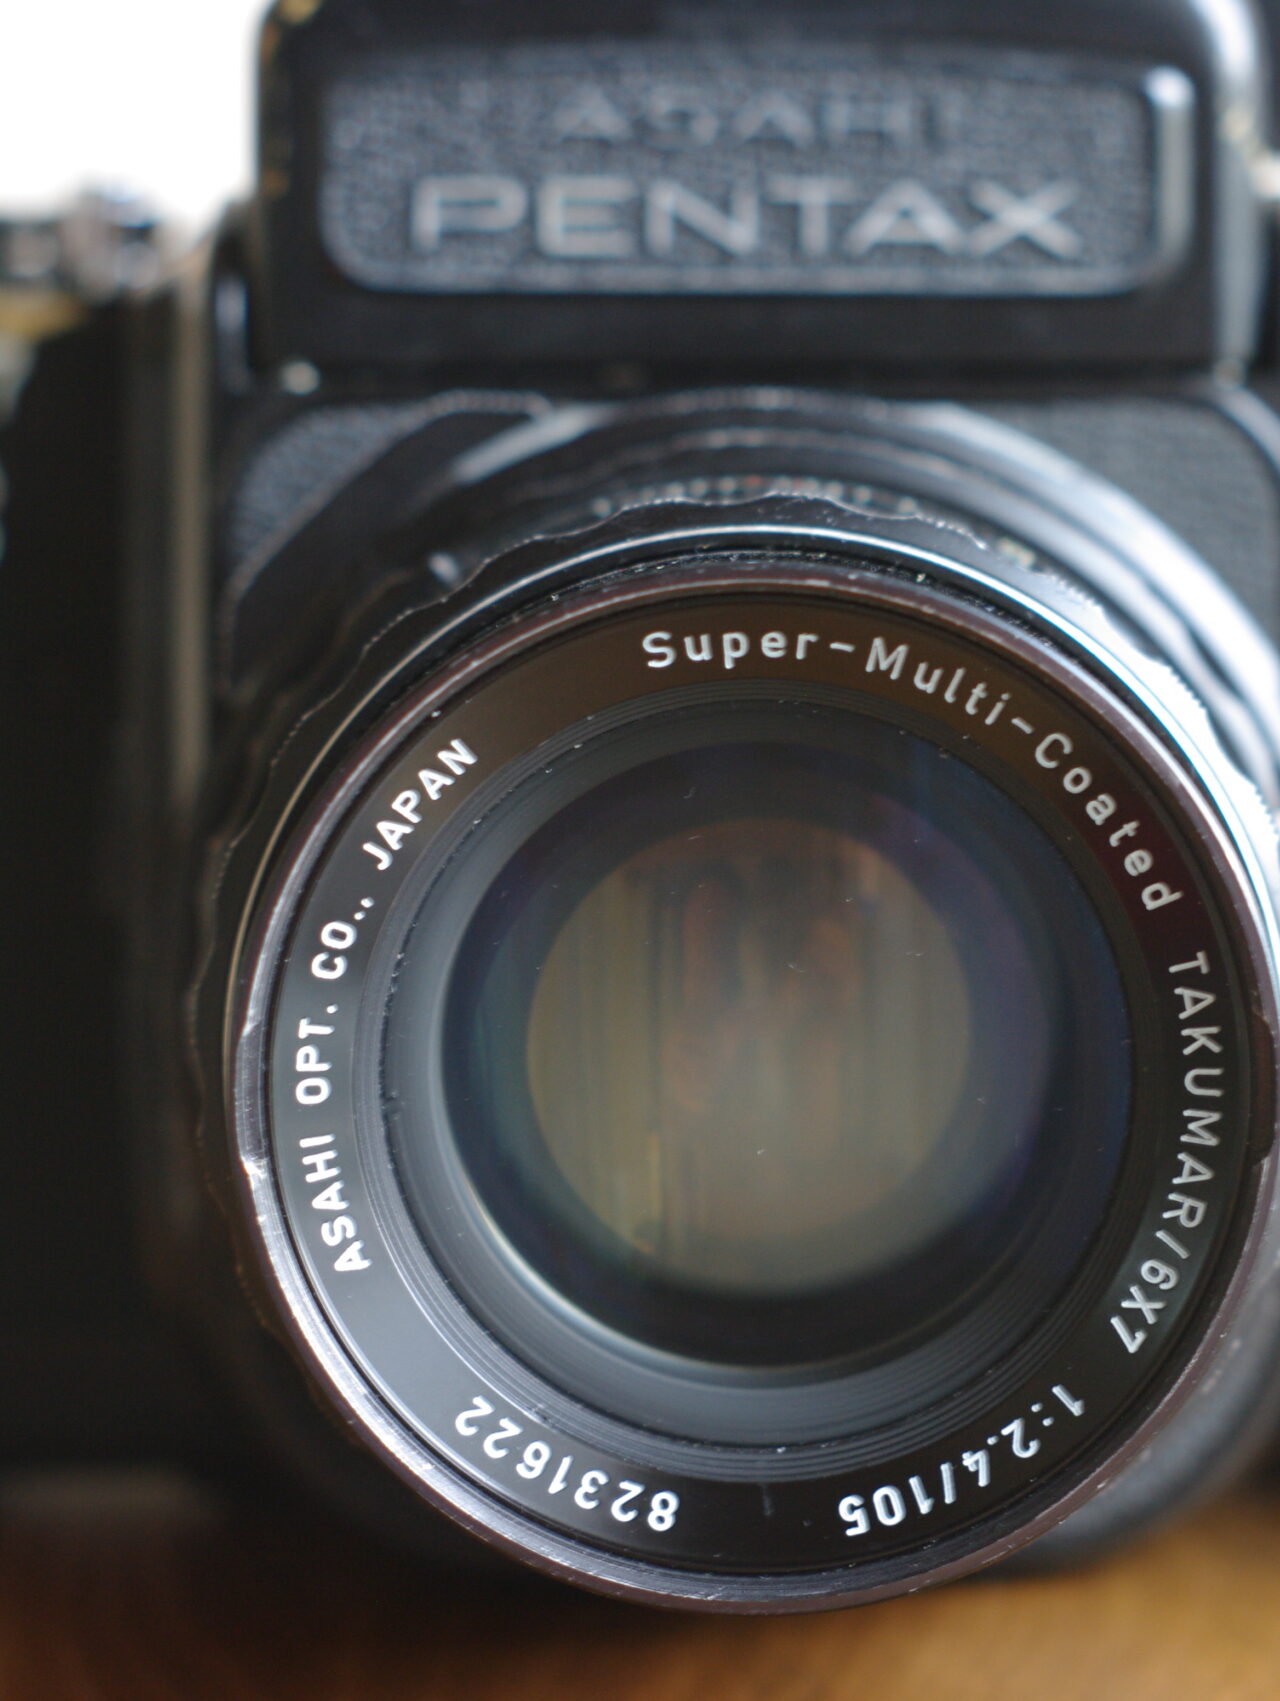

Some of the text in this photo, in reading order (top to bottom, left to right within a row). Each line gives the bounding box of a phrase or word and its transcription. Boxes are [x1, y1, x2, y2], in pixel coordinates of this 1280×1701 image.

[552, 84, 962, 148] ASAHI
[409, 175, 1086, 258] PENTAX
[362, 738, 479, 871] JAPAN
[642, 630, 1183, 911] Super-Multi-Coated
[295, 1003, 339, 1105] OPT.
[299, 1133, 373, 1272] ASAHI
[1110, 951, 1224, 1354] TAKUMAR/6X7
[454, 1395, 681, 1532] 8231622
[838, 1384, 1085, 1537] 1:2.4/105
